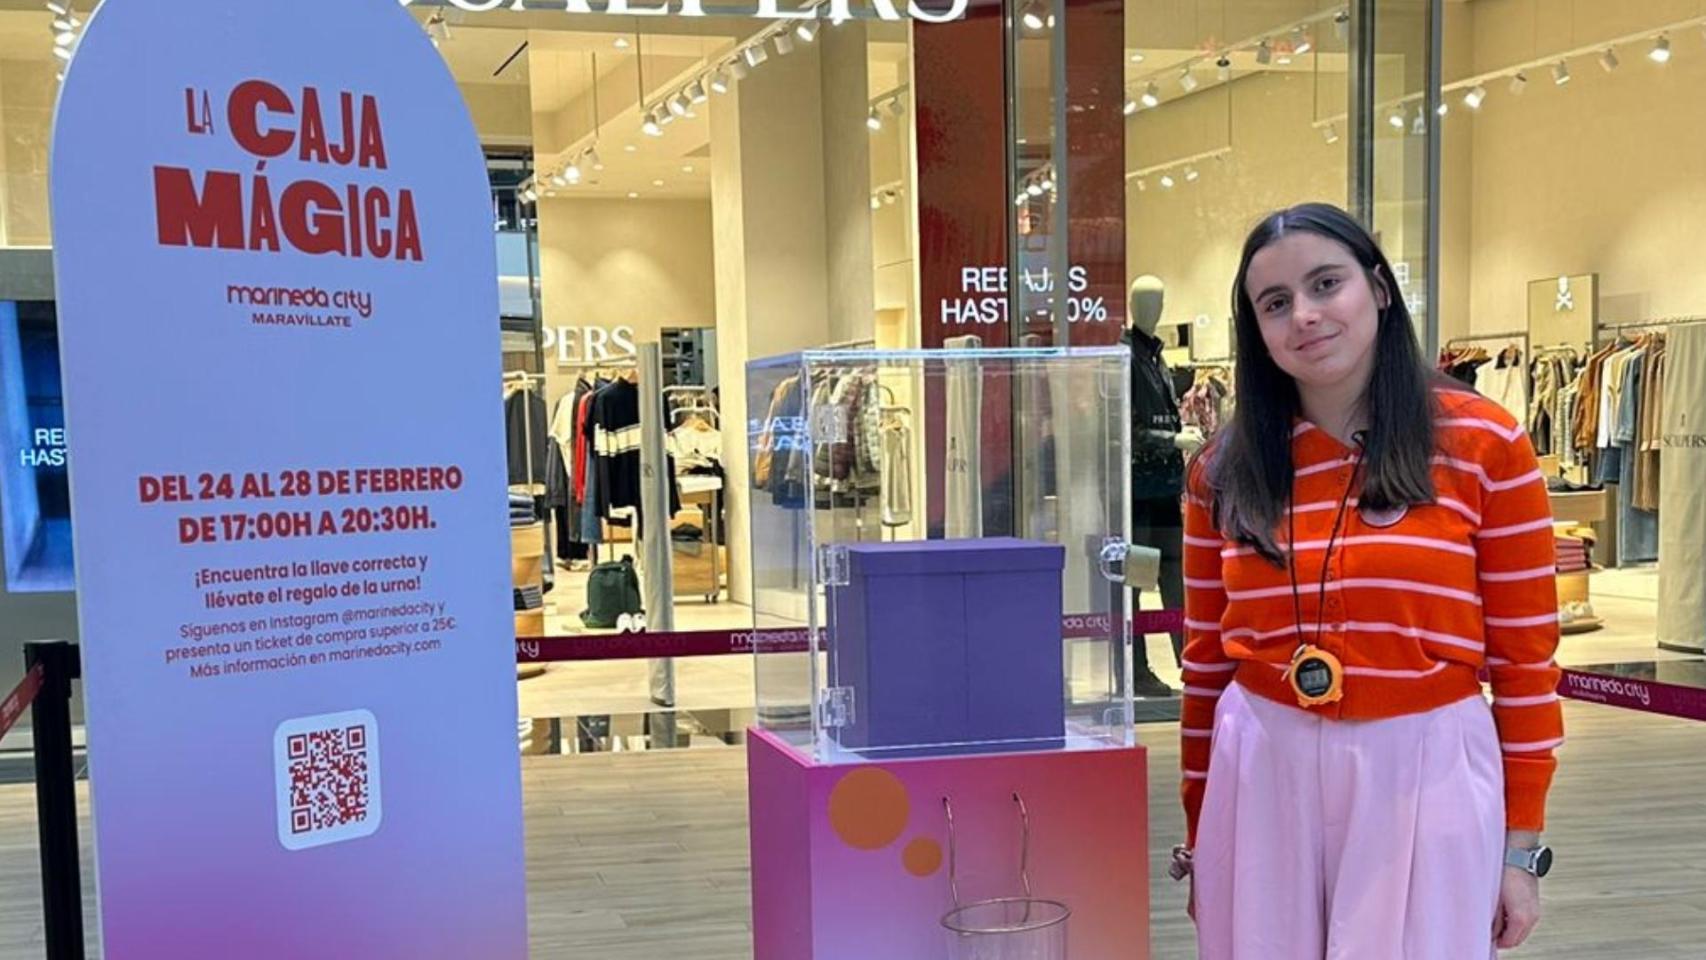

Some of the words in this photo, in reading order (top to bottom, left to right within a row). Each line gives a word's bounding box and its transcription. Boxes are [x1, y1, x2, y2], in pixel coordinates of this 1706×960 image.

[185, 87, 214, 135] LA
[227, 79, 388, 170] CAJA
[153, 160, 424, 261] MÁGICA
[227, 285, 329, 307] marineda
[333, 289, 372, 318] city
[139, 475, 193, 502] DEL
[198, 473, 234, 499] 24
[241, 472, 276, 499] AL
[280, 470, 312, 497] 28
[317, 469, 350, 495] DE
[355, 466, 463, 494] FEBRERO
[179, 517, 216, 543] DE
[221, 511, 313, 541] 17:00H
[317, 510, 337, 536] A
[342, 505, 437, 533] 20:30H.
[195, 563, 289, 589] ¡Encuentra
[292, 562, 308, 577] la
[311, 559, 350, 577] llave
[352, 555, 416, 573] correcta
[418, 555, 428, 572] y
[205, 588, 264, 609] llévate
[268, 587, 283, 604] el
[286, 583, 337, 606] regalo
[341, 580, 361, 597] de
[364, 579, 378, 595] la
[381, 576, 421, 594] urna!
[180, 617, 246, 642] Síguenos
[250, 619, 267, 632] en
[270, 611, 338, 635] Instagram
[342, 601, 435, 625] @marinedacity
[436, 601, 445, 614] y
[165, 643, 231, 664] presenta
[234, 640, 251, 654] un
[255, 634, 292, 651] ticket
[296, 632, 313, 647] de
[315, 628, 366, 650] compra
[369, 622, 418, 645] superior
[421, 621, 430, 633] a
[190, 660, 220, 678] Más
[223, 652, 307, 674] información
[310, 652, 327, 665] en
[329, 638, 441, 662] marinedacity.com
[1568, 673, 1624, 696] marineda
[1624, 681, 1651, 706] city
